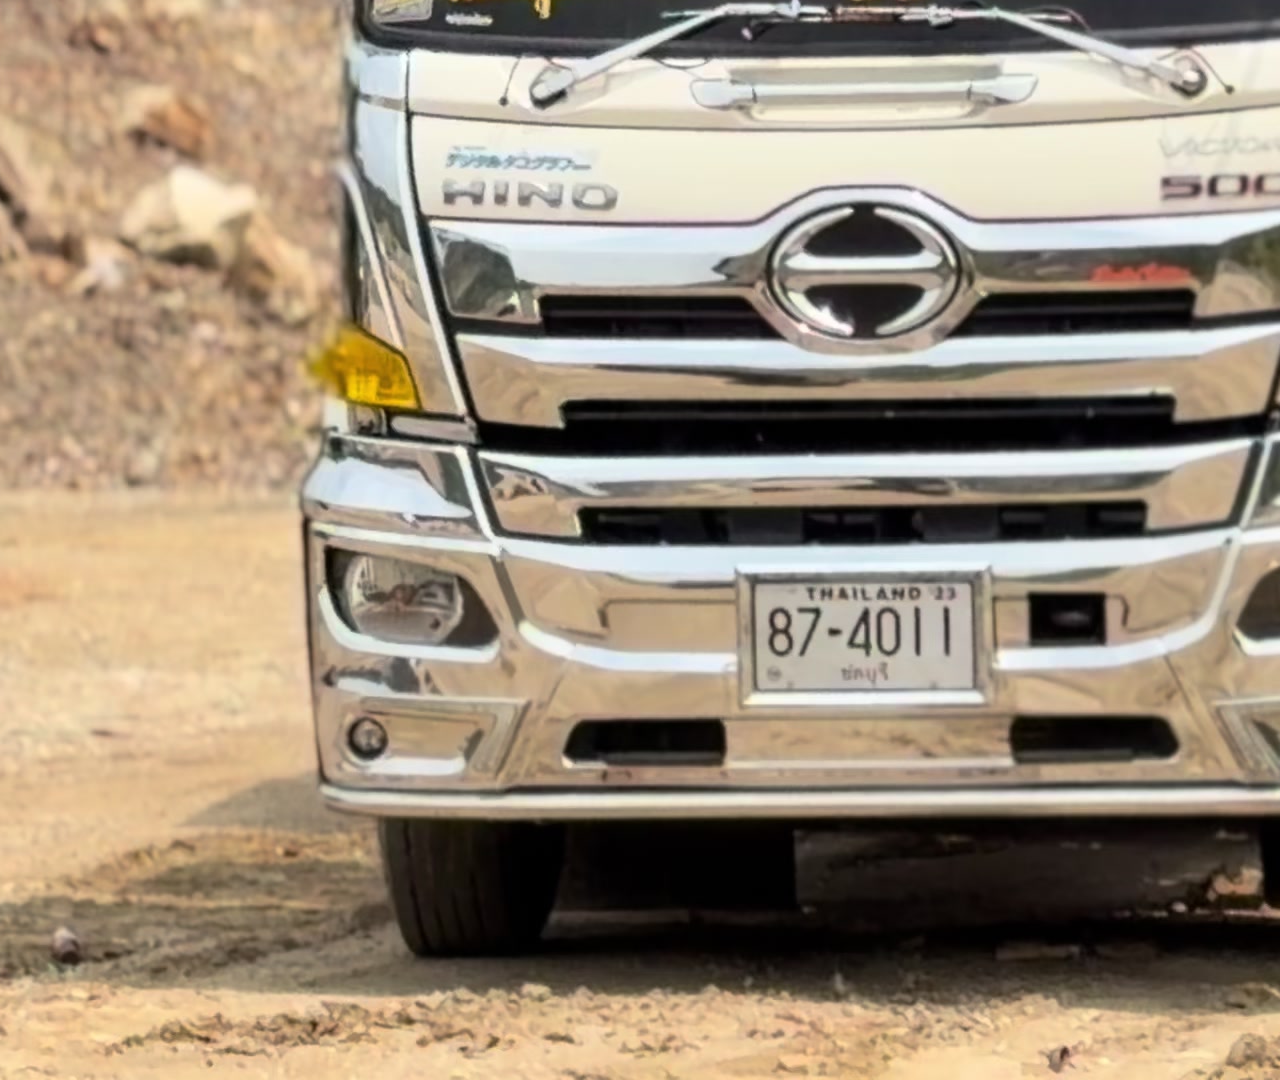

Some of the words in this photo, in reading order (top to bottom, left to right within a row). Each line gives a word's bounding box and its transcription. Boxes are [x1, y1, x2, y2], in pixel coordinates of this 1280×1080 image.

[443, 178, 618, 211] HINO
[807, 586, 922, 601] THAILAND
[768, 606, 951, 657] 87-4011
